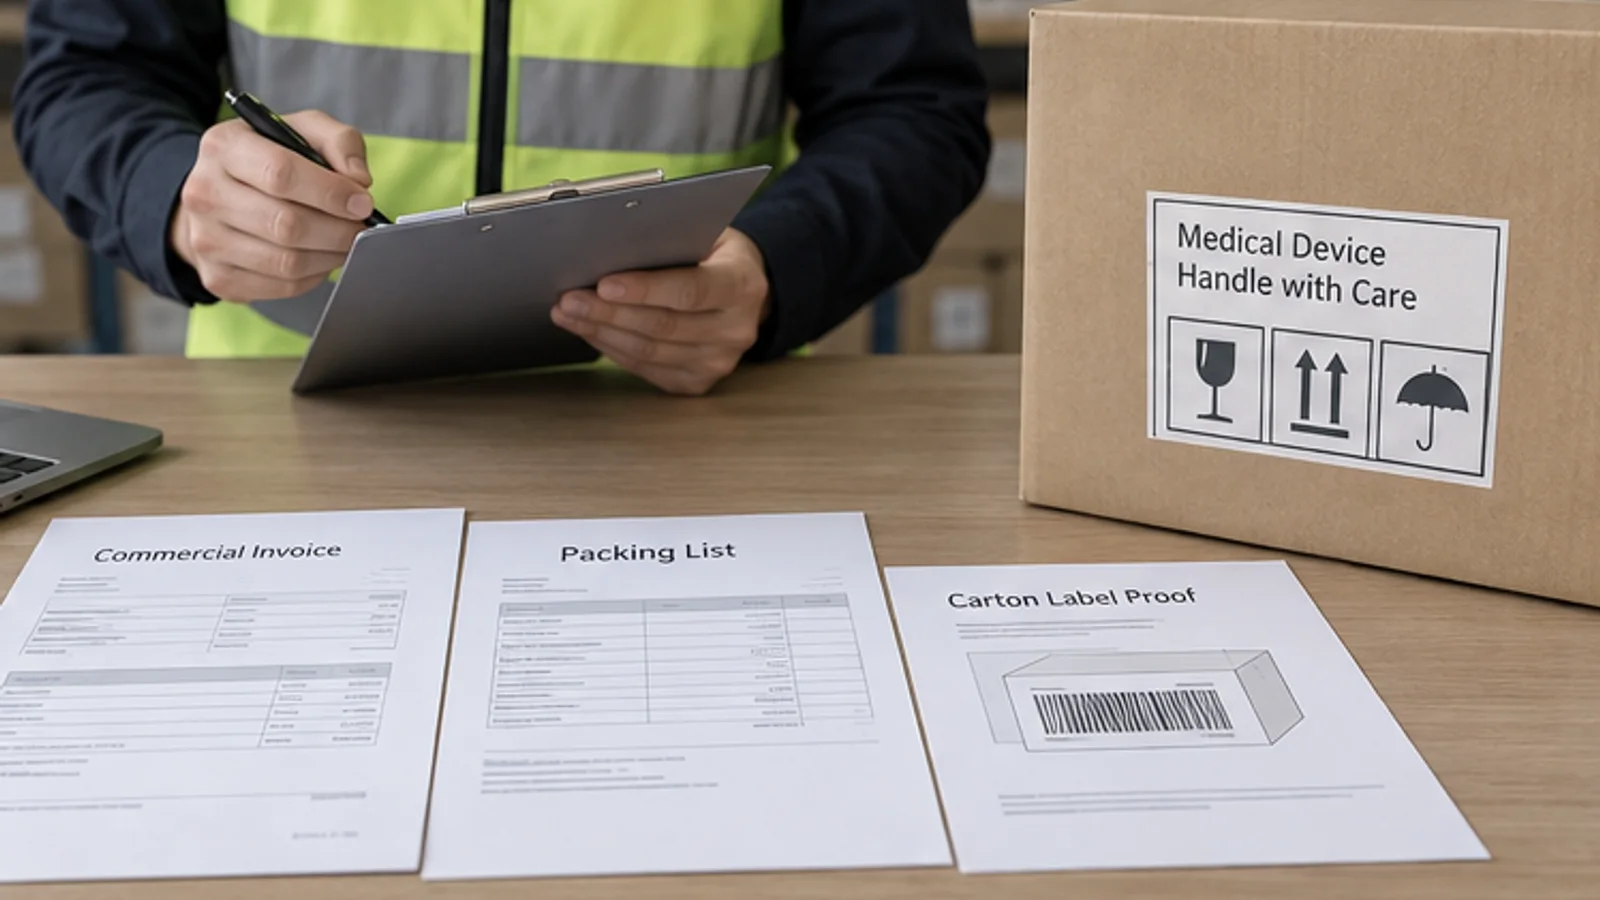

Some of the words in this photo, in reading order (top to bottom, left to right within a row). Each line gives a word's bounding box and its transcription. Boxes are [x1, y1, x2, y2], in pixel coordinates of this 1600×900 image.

[1178, 222, 1282, 257] Medical
[1292, 232, 1386, 267] Device
[1178, 262, 1274, 296] Handle
[1281, 272, 1342, 304] with
[1351, 278, 1418, 311] Care
[94, 544, 246, 563] Commercial
[251, 542, 342, 559] Invoice
[560, 543, 676, 565] Packing
[685, 541, 736, 559] List
[947, 593, 1040, 609] Carton
[1045, 589, 1118, 607] Label
[1124, 586, 1196, 604] Proof
